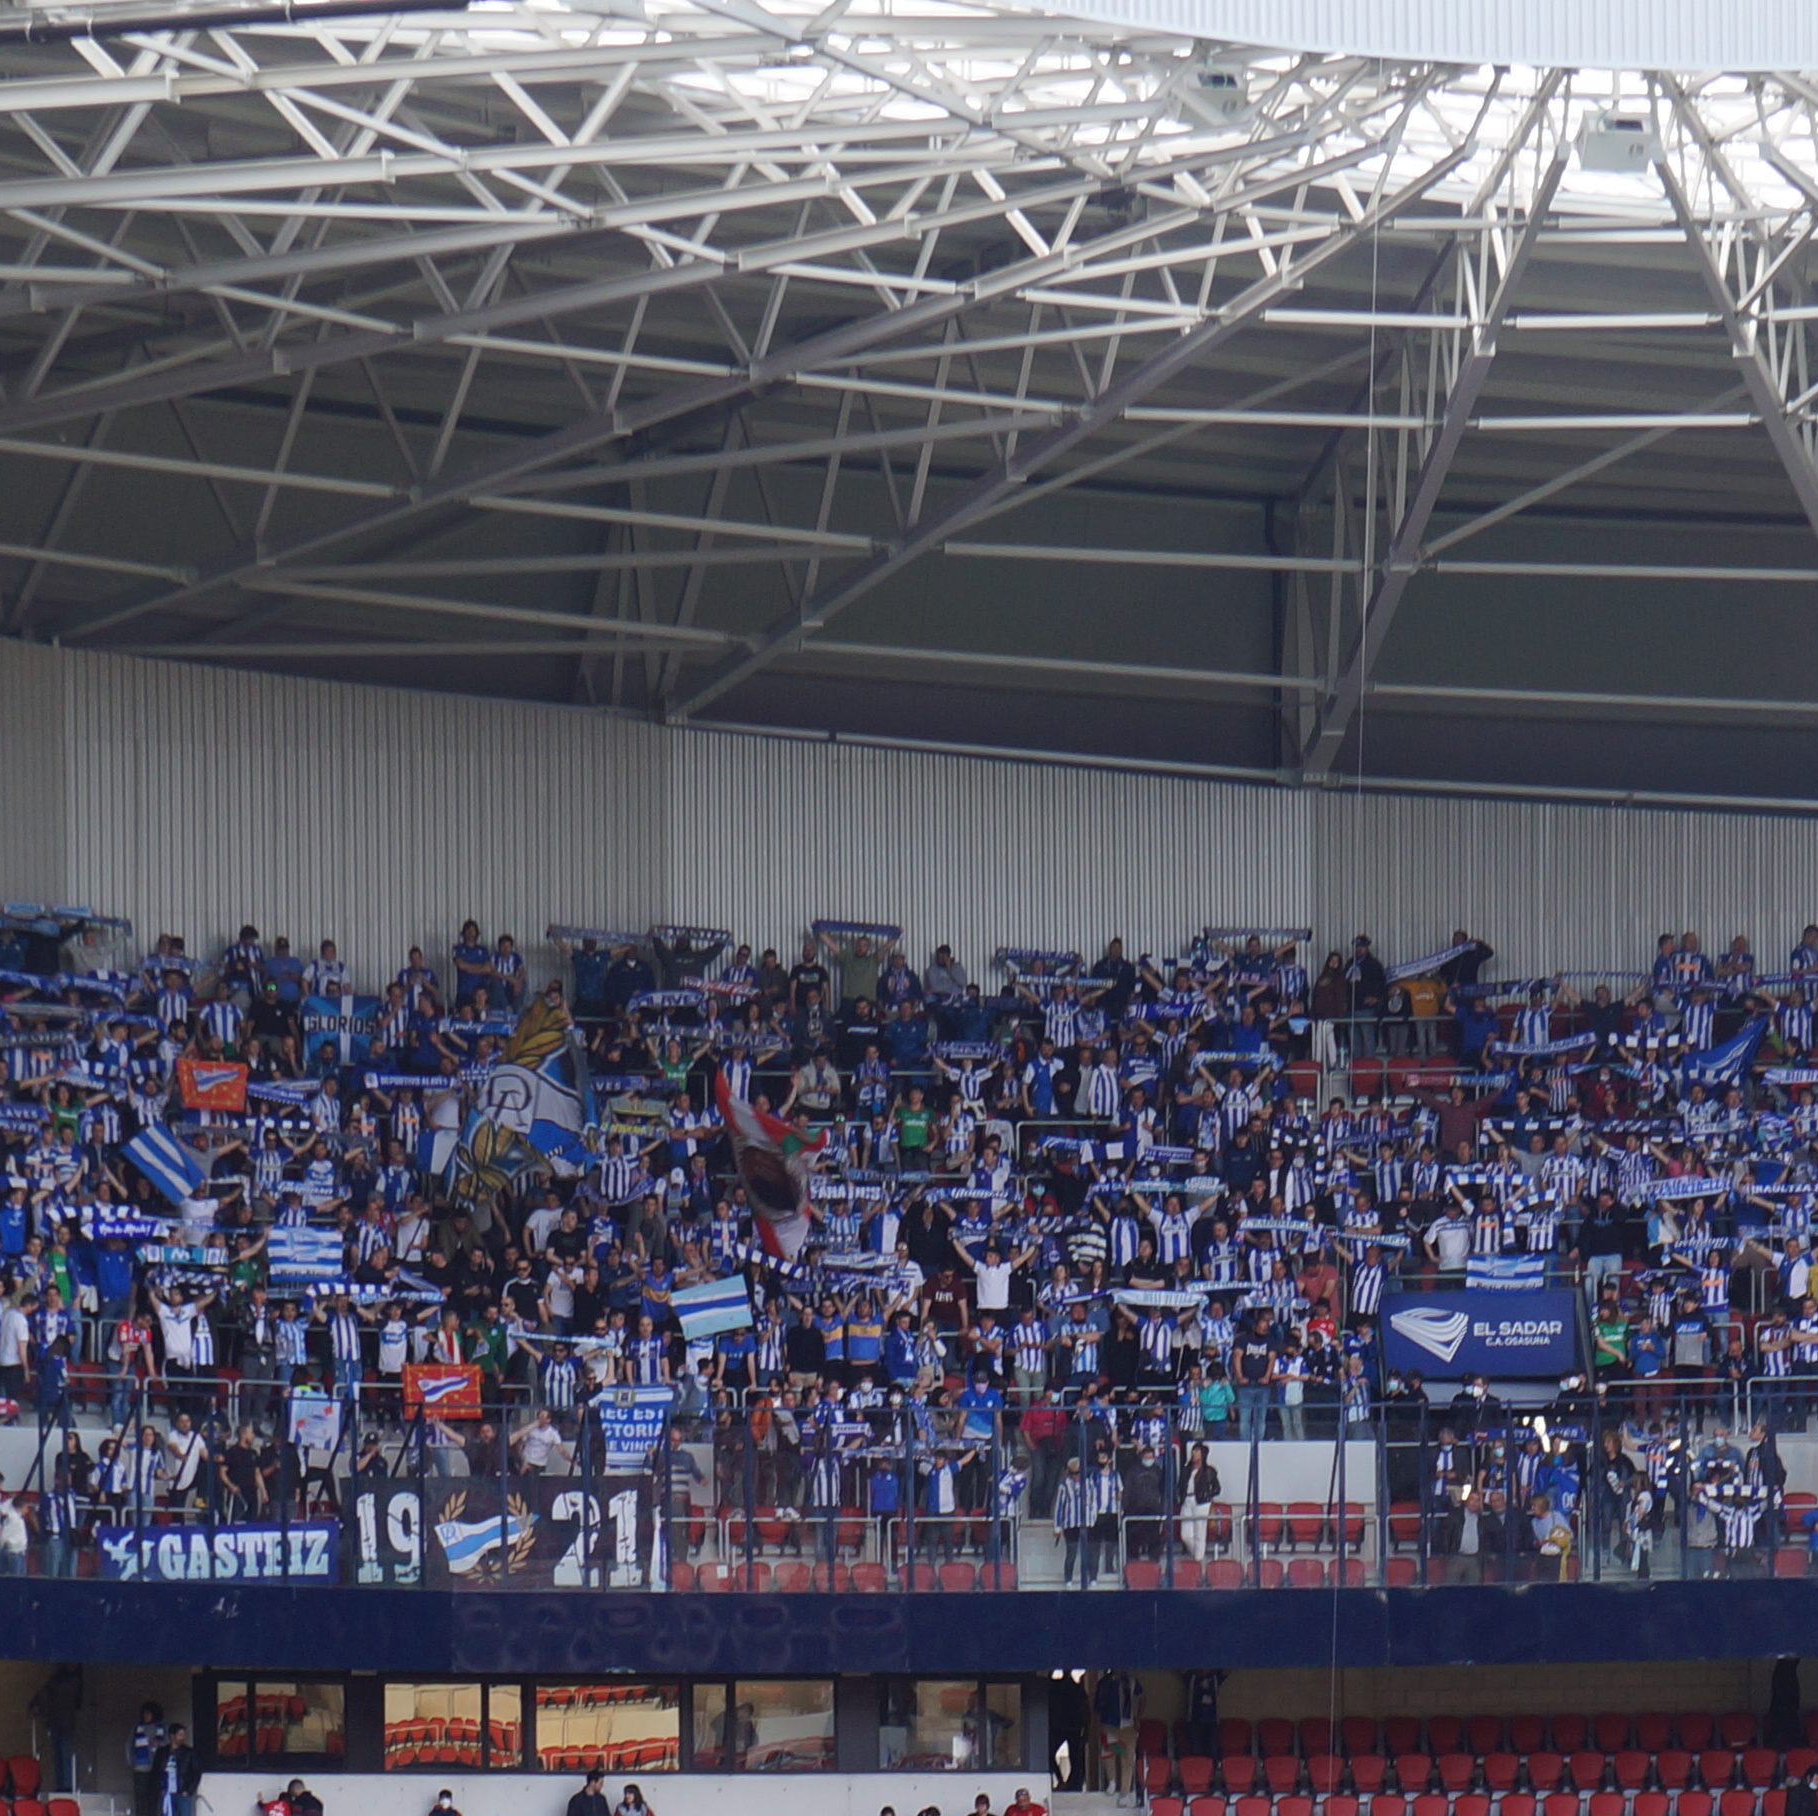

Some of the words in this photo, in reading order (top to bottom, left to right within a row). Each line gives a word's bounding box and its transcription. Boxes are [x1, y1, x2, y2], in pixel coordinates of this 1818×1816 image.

[1473, 1321, 1497, 1337] EL
[1498, 1320, 1563, 1337] SADAR
[1485, 1335, 1503, 1347] C.A.
[1502, 1335, 1551, 1347] OSASUNA
[158, 1529, 330, 1580] GASTEIZ
